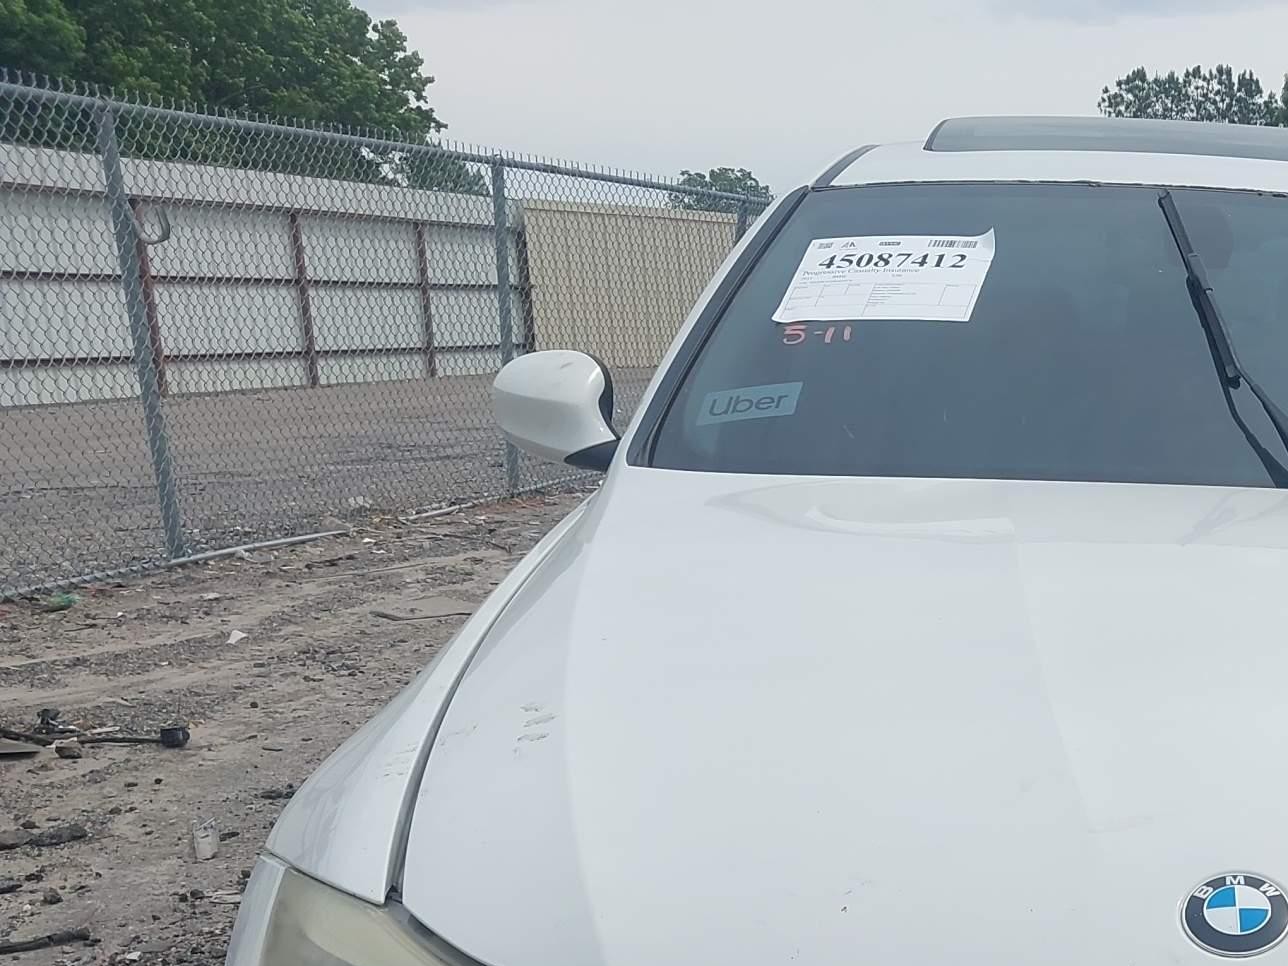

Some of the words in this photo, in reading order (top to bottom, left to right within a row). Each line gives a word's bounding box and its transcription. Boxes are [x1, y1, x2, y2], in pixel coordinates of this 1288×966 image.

[818, 252, 967, 269] 45087412
[783, 324, 852, 345] 5-11
[709, 394, 789, 417] Uber
[1193, 875, 1281, 899] BMW
